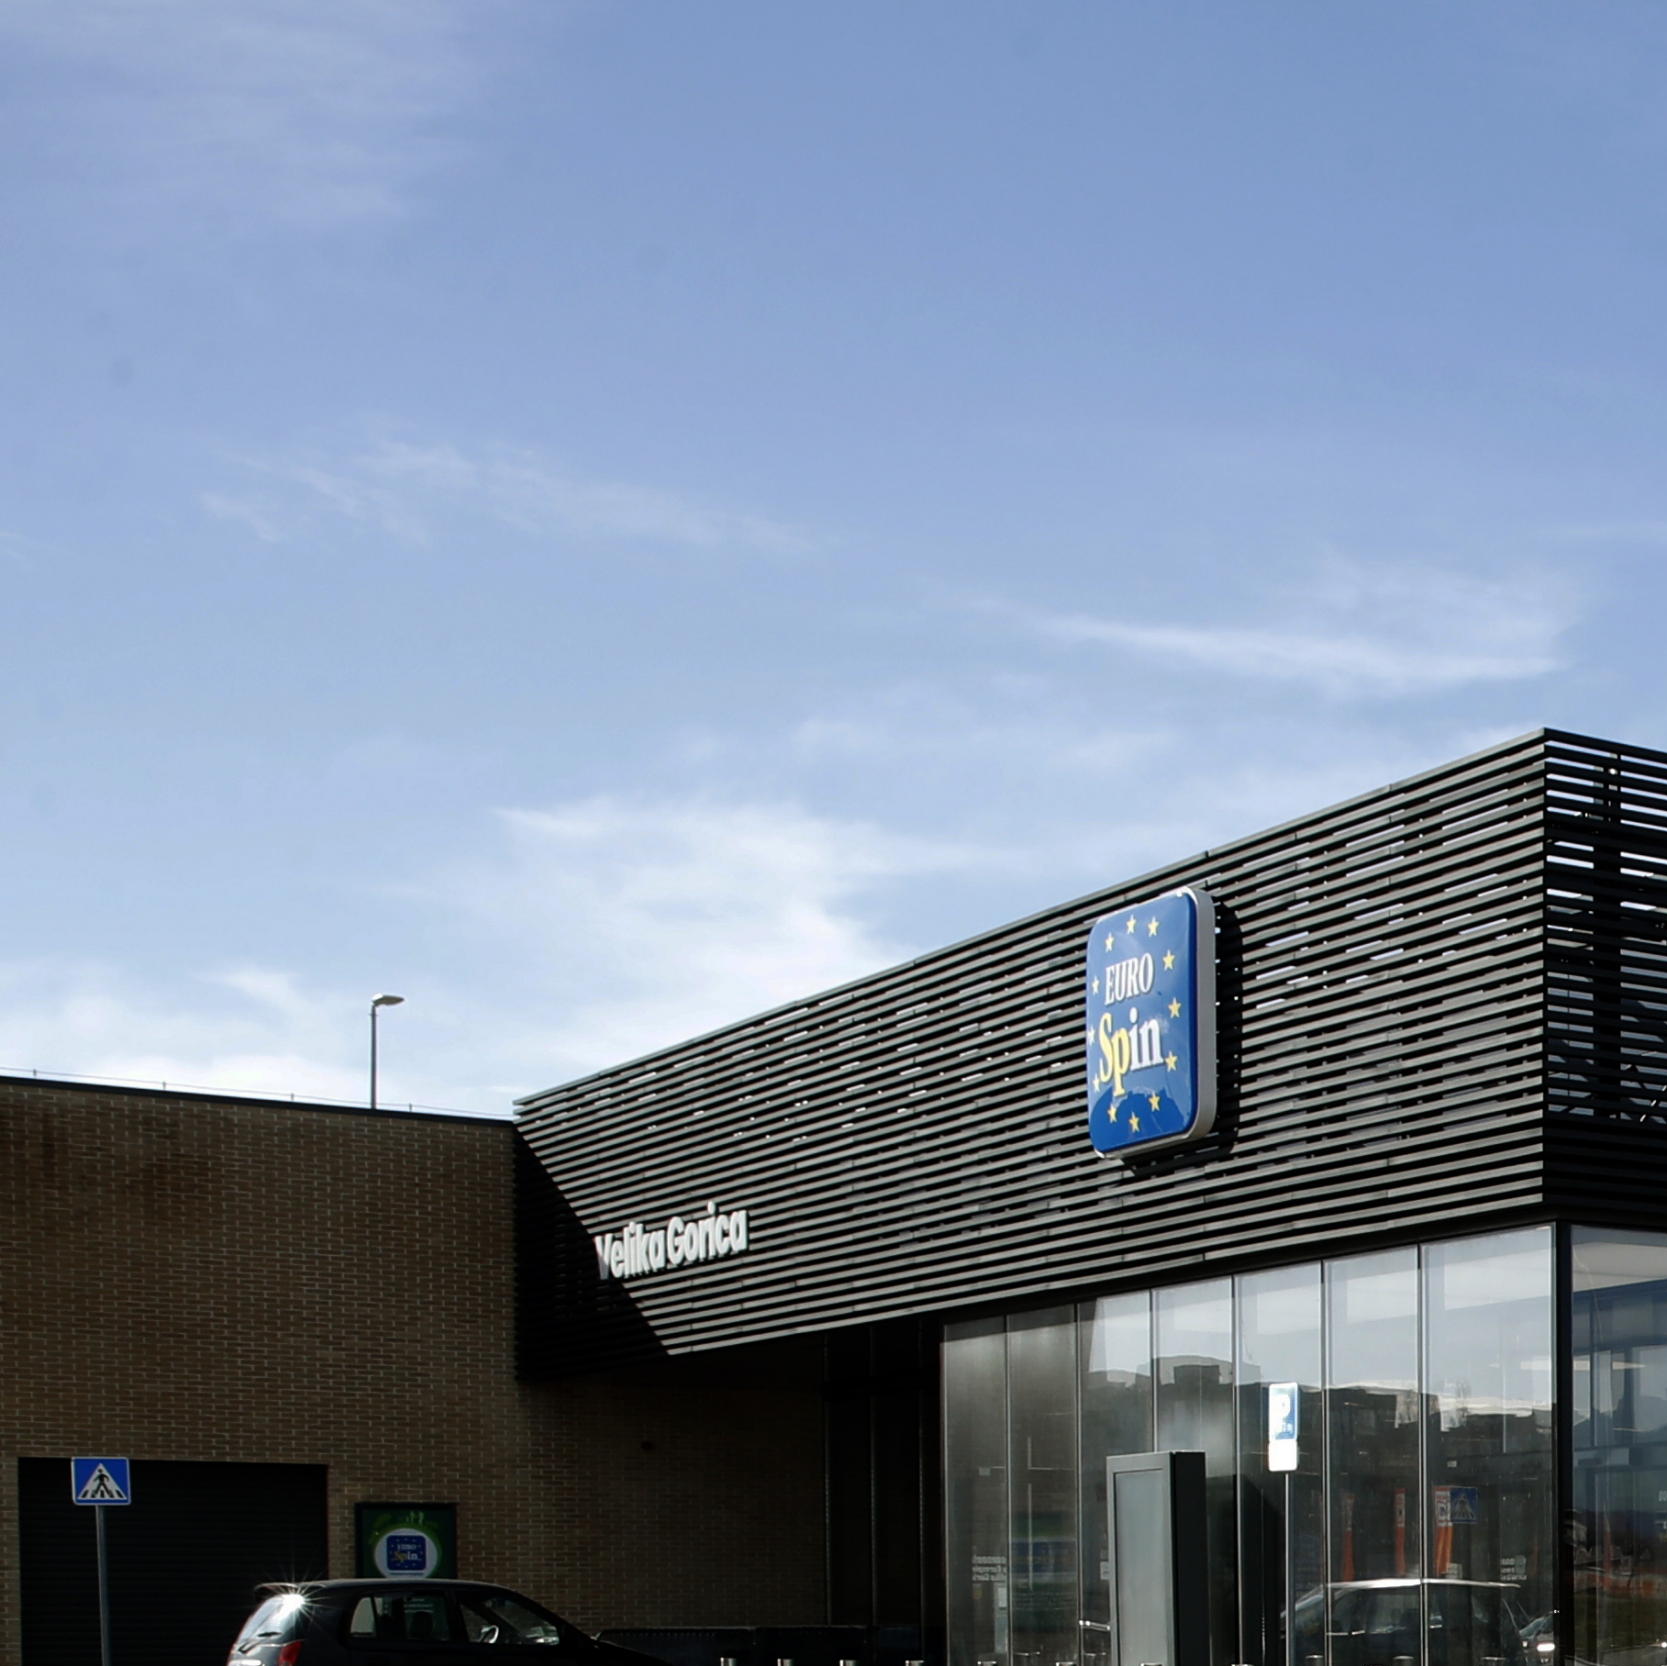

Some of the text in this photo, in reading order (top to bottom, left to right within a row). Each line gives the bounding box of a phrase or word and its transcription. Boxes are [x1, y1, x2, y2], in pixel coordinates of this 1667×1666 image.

[1104, 953, 1154, 1005] EURO
[1099, 1007, 1164, 1096] Spin
[595, 1200, 748, 1280] Velika Gorica
